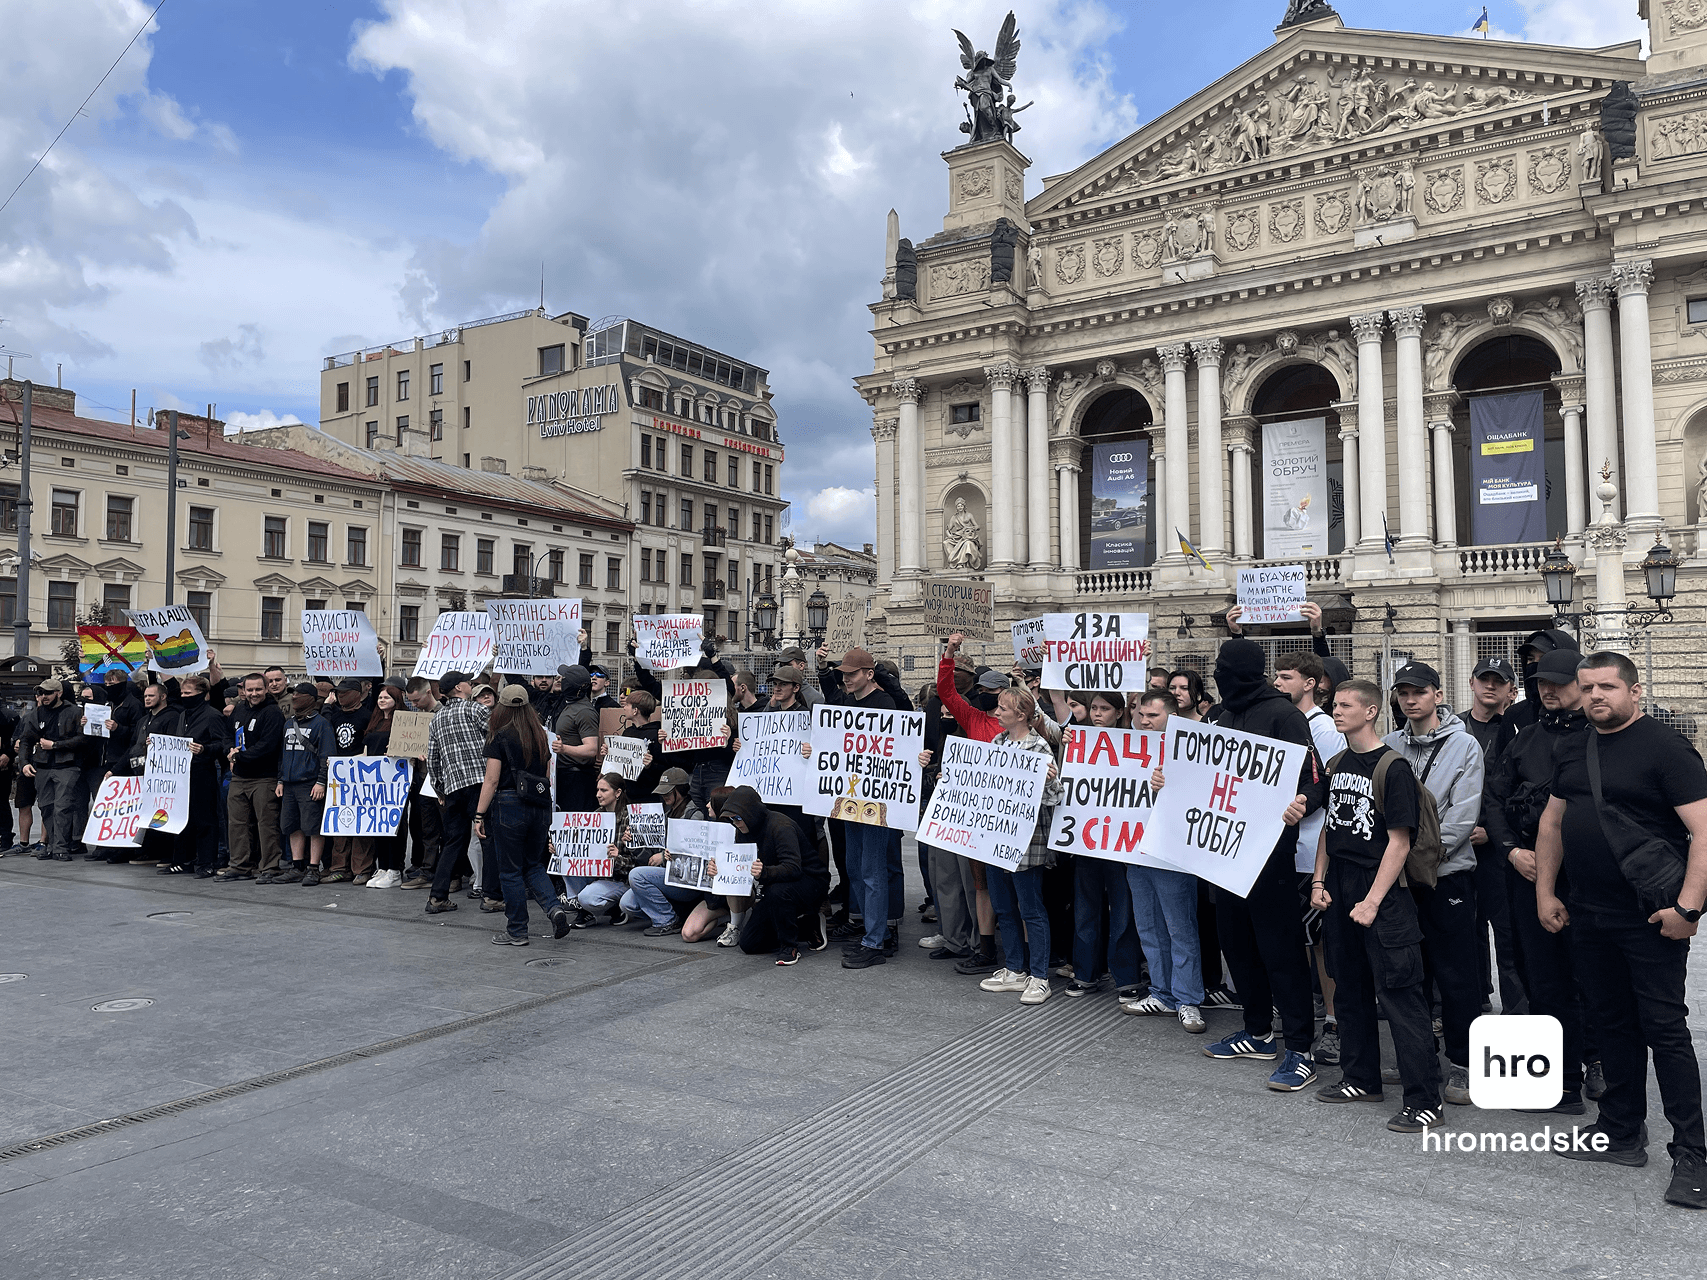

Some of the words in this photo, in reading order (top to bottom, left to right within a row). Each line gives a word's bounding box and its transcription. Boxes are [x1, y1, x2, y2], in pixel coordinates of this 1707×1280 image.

[526, 383, 618, 425] PANORAMA
[540, 421, 566, 438] Lviv
[566, 416, 600, 434] Hotel
[1270, 454, 1319, 467] ЗОЛОТИЙ
[1272, 464, 1317, 477] ОБРУЧ
[1109, 467, 1133, 475] Новий
[1241, 573, 1256, 583] МИ
[490, 601, 579, 620] УКРАЇНСЬКА
[303, 612, 359, 634] ЗАХИСТИ
[498, 623, 545, 641] РОДИНА
[1069, 612, 1087, 640] Я
[1092, 613, 1121, 639] ЗА
[321, 631, 361, 645] РОДИНУ
[427, 634, 491, 659] ПРОТИ
[1026, 636, 1035, 645] НЕ
[305, 645, 356, 659] ЗБЕРЕЖИ
[1044, 637, 1147, 663] ТРАДИЦІЙНУ
[314, 659, 358, 671] УКРАЇНУ
[494, 656, 532, 670] ДИТИНА
[1064, 661, 1124, 690] СІМ'Ю
[673, 682, 712, 696] ШЛЮБ
[664, 695, 676, 708] ЦЕ
[681, 695, 709, 708] СОЮЗ
[672, 718, 686, 728] ВСЕ
[741, 716, 752, 742] Є
[753, 713, 795, 739] ТІЛЬКИ
[819, 708, 895, 735] ПРОСТИ
[158, 736, 167, 751] ЗА
[752, 738, 802, 757] ГЕНДЕРИ
[843, 732, 895, 758] БОЖЕ
[736, 756, 781, 778] ЧОЛОВІК
[818, 751, 840, 772] БО
[985, 746, 1008, 768] ХТО
[1010, 752, 1042, 774] ЛЯЖЕ
[1172, 729, 1286, 787] ГОМОФОБІЯ
[942, 767, 950, 784] З
[146, 778, 152, 793] Я
[153, 779, 178, 794] ПРОТИ
[755, 775, 793, 797] ЖІНКА
[818, 775, 844, 797] ЩО
[1208, 772, 1244, 814] НЕ
[562, 812, 602, 828] ДЯКУЮ
[931, 803, 966, 825] ВОНИ
[966, 811, 1019, 837] ЗРОБИЛИ
[1054, 815, 1076, 847] З
[1185, 807, 1247, 860] ФОБІЯ
[563, 843, 590, 858] ДАЛИ
